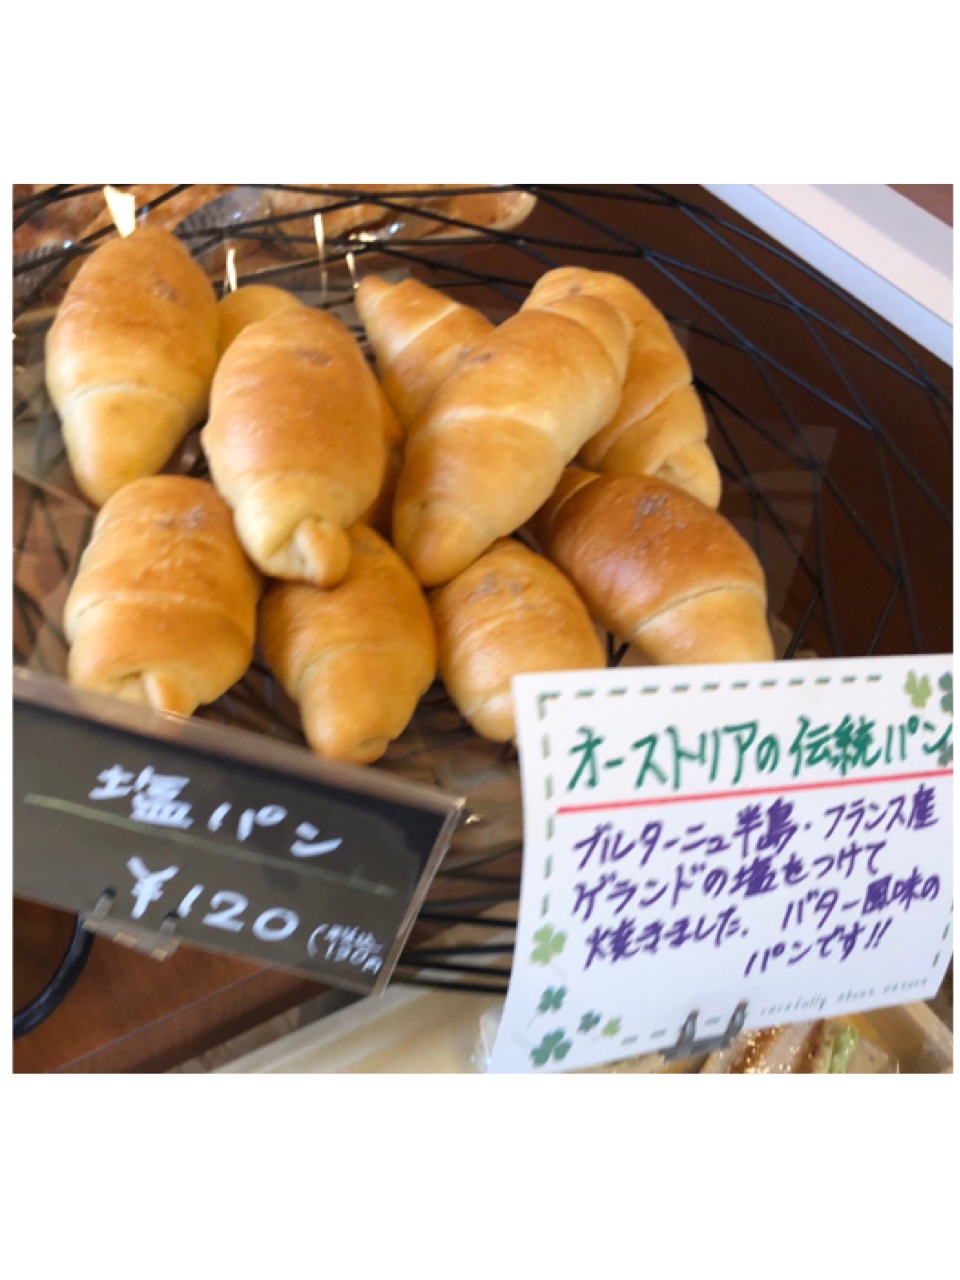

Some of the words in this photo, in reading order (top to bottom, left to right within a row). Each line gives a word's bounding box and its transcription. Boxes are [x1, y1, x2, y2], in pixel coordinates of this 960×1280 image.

[567, 713, 953, 791] オーストリアの伝統パン
[89, 764, 343, 858] 塩パン
[572, 840, 888, 921] ゲランドの塩をつけて
[781, 866, 941, 930] バター風味の
